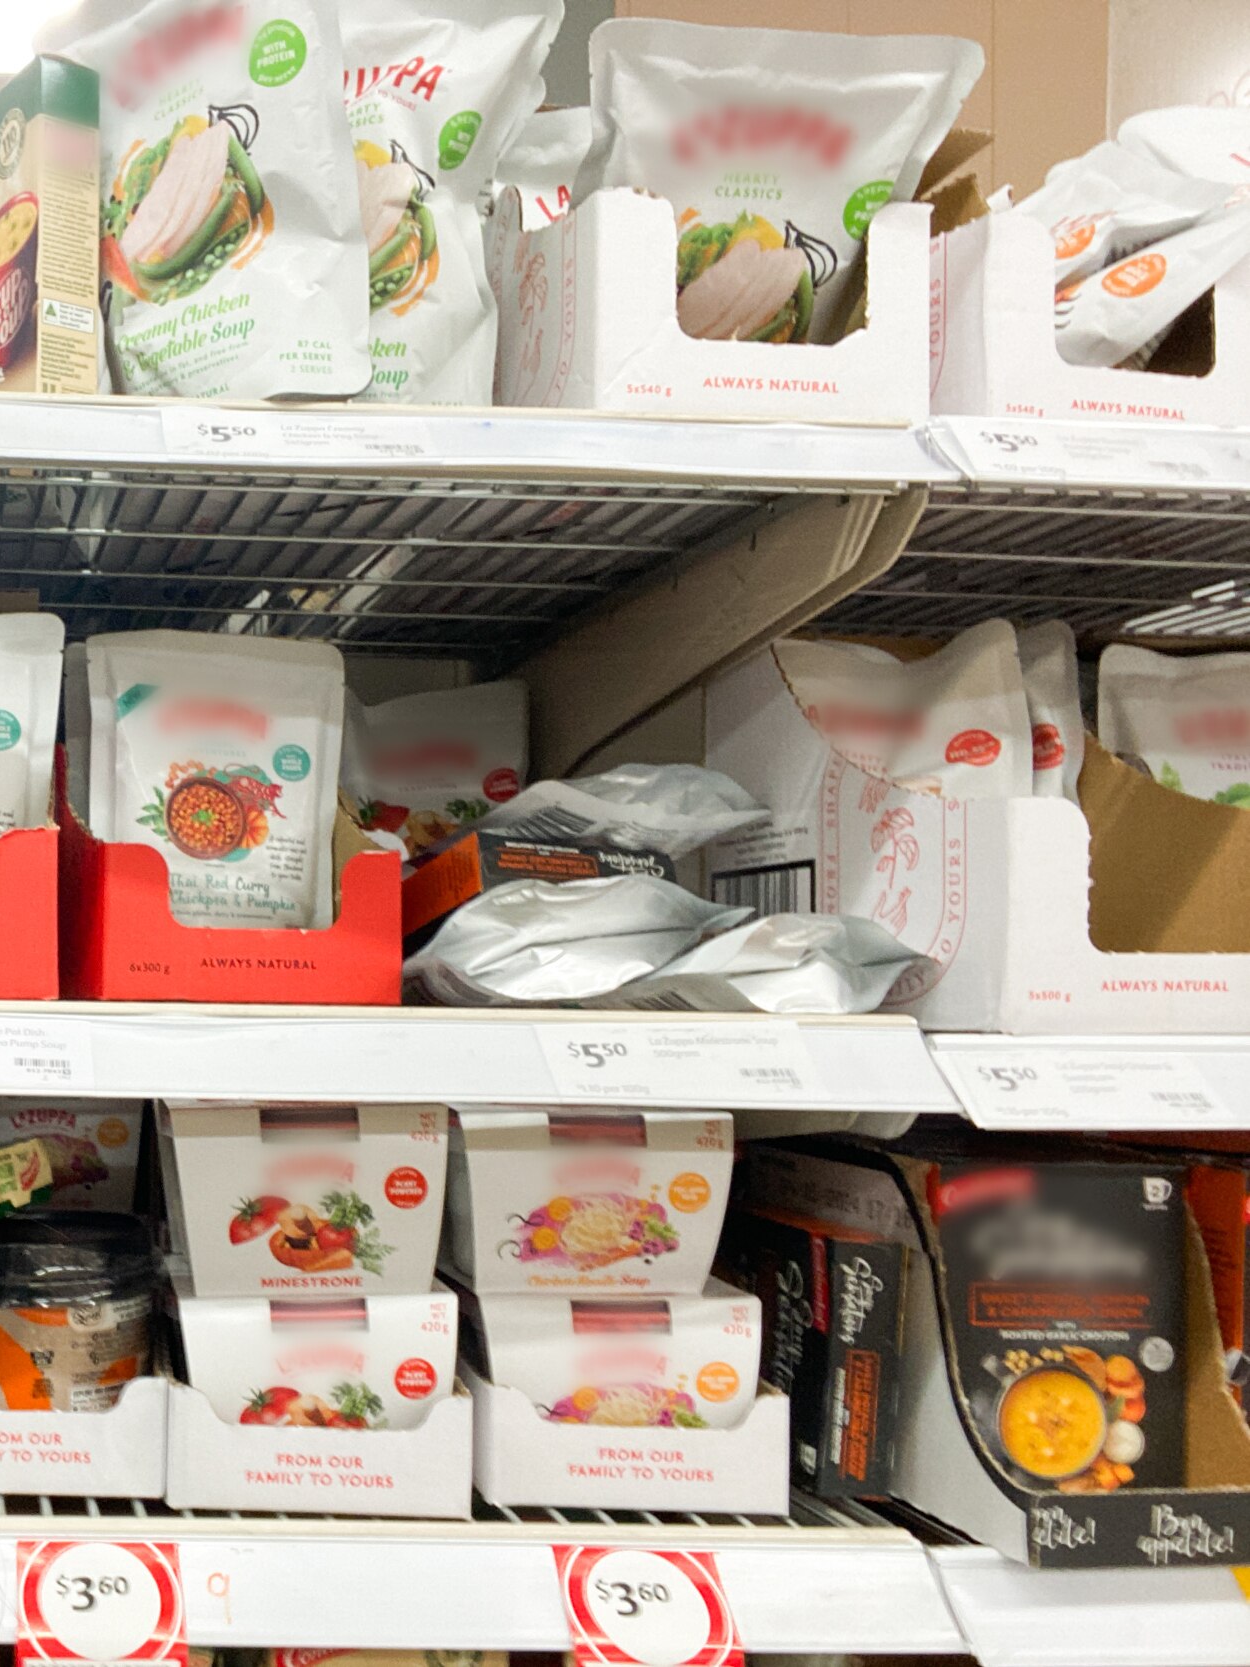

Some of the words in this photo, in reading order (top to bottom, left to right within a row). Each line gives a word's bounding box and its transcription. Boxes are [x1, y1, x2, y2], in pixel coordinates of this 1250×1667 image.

[262, 40, 287, 54] WITH
[257, 50, 296, 68] PROTEIN
[723, 172, 781, 185] HEARTY
[714, 186, 783, 200] CLASSICS
[536, 185, 572, 223] LA
[181, 293, 250, 326] Chicken
[210, 318, 255, 343] Soup
[297, 340, 310, 350] 87
[313, 340, 332, 350] CAL
[279, 353, 298, 362] PER
[302, 352, 332, 362] SERVE
[299, 365, 333, 375] SERVES
[372, 364, 409, 391] oup
[665, 387, 672, 397] g
[703, 376, 763, 390] ALWAYS
[769, 378, 839, 394] NATURAL
[1071, 399, 1122, 414] ALWAYS
[1127, 403, 1185, 420] NATURAL
[170, 872, 197, 888] Thai
[205, 874, 229, 889] Red
[236, 876, 270, 898] Curry
[948, 837, 962, 923] YOURS
[247, 893, 296, 915] Pumpkin
[130, 962, 161, 973] 6x300
[163, 964, 170, 975] g
[201, 957, 251, 969] ALWAYS
[257, 959, 317, 970] NATURAL
[1101, 980, 1158, 992] ALWAYS
[1163, 980, 1229, 992] NATURAL
[1029, 990, 1061, 1001] 5x500
[1064, 993, 1071, 1004] g
[5, 1027, 22, 1036] Pot
[23, 1028, 45, 1037] Dish
[10, 1038, 38, 1049] Pump
[41, 1039, 67, 1050] Soup
[28, 1108, 76, 1129] ZUPPA
[261, 1276, 363, 1288] MINESTRONE
[620, 1275, 650, 1288] Soup
[430, 1302, 447, 1311] NET
[421, 1321, 441, 1332] 420
[442, 1323, 450, 1335] g
[723, 1324, 743, 1335] 420
[1000, 1329, 1045, 1341] ROASTED
[1046, 1330, 1079, 1341] GARLIC
[29, 1432, 62, 1445] OUR
[12, 1450, 33, 1462] TO
[39, 1451, 91, 1464] YOURS
[276, 1454, 322, 1467] FROM
[328, 1456, 363, 1469] OUR
[599, 1448, 644, 1461] FROM
[650, 1450, 684, 1463] OUR
[245, 1471, 304, 1485] FAMILY
[310, 1473, 333, 1486] TO
[340, 1475, 394, 1488] YOURS
[567, 1465, 625, 1478] FAMILY
[632, 1467, 654, 1479] TO
[660, 1469, 714, 1482] YOURS
